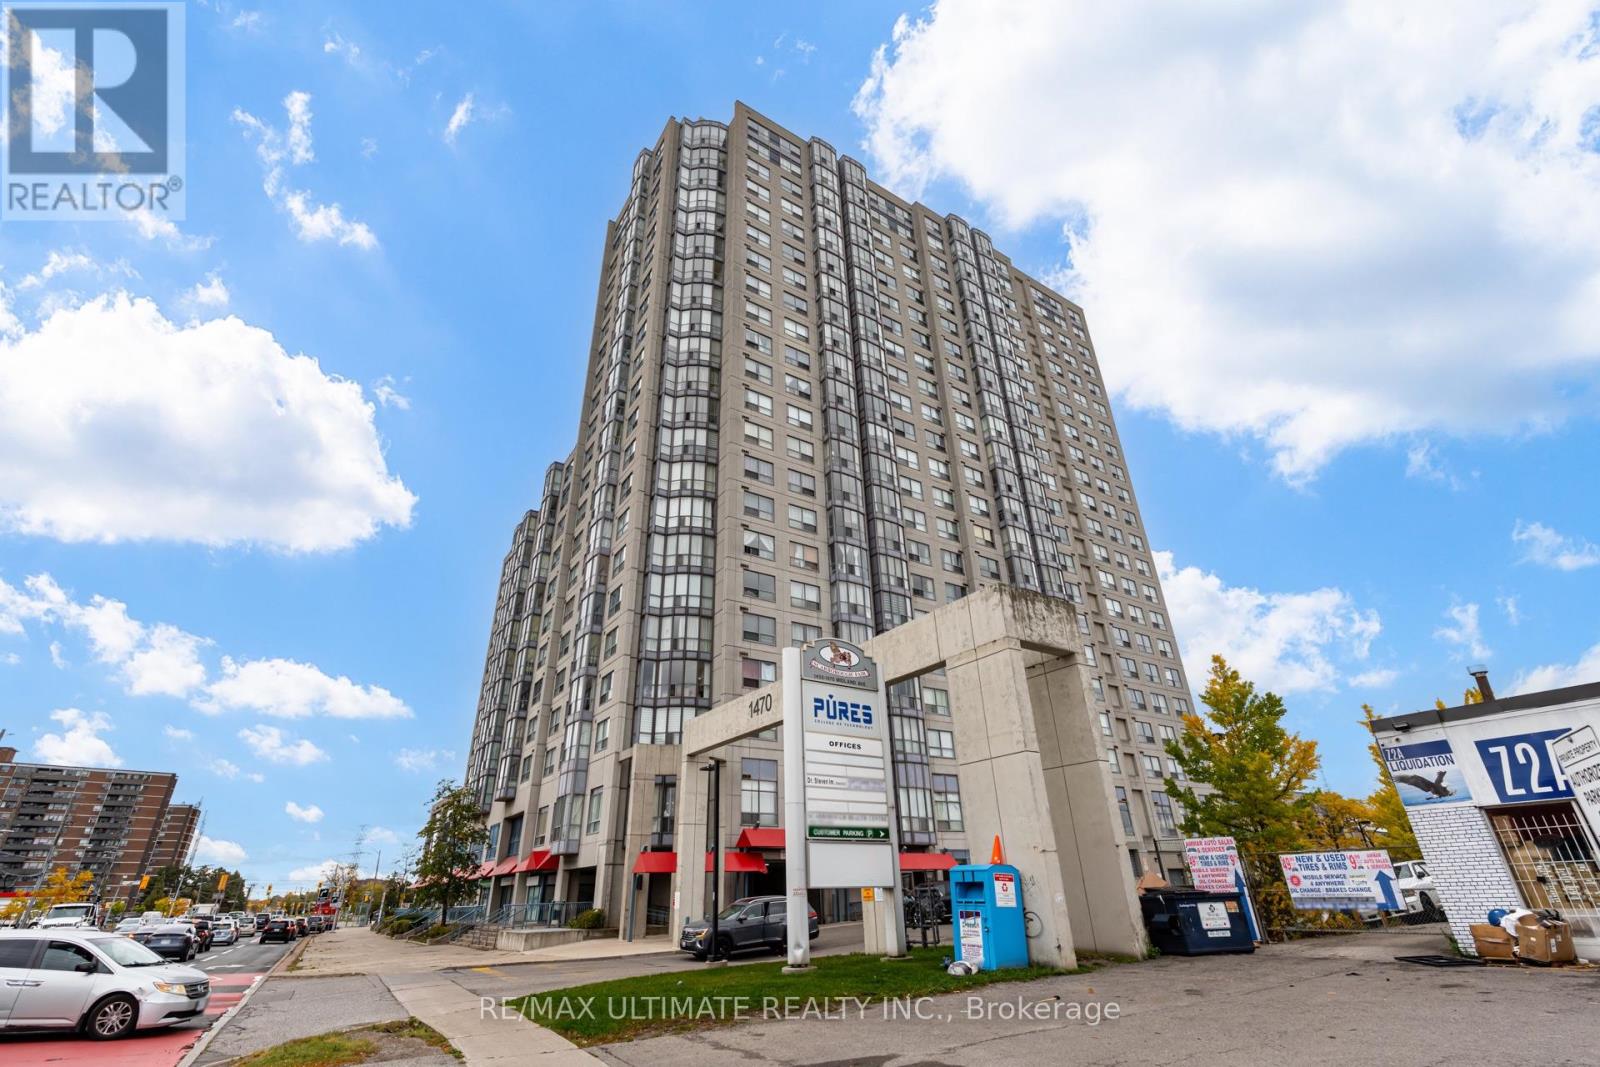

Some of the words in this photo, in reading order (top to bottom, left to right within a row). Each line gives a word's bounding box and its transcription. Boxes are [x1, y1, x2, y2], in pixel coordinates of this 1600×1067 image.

[749, 693, 772, 718] 1470
[829, 740, 862, 750] OFFICES
[1385, 748, 1405, 761] Z2A
[1558, 749, 1575, 762] PRIVATE
[1573, 740, 1597, 755] PROPERTY
[1389, 754, 1456, 772] LIQUIDATION
[812, 829, 841, 837] CUSTOMER
[842, 829, 864, 838] PARKING
[1295, 855, 1313, 863] NEW
[1323, 853, 1347, 862] USED
[1298, 862, 1321, 871] TIRES
[1321, 862, 1327, 870] &
[1328, 861, 1348, 870] RIMS
